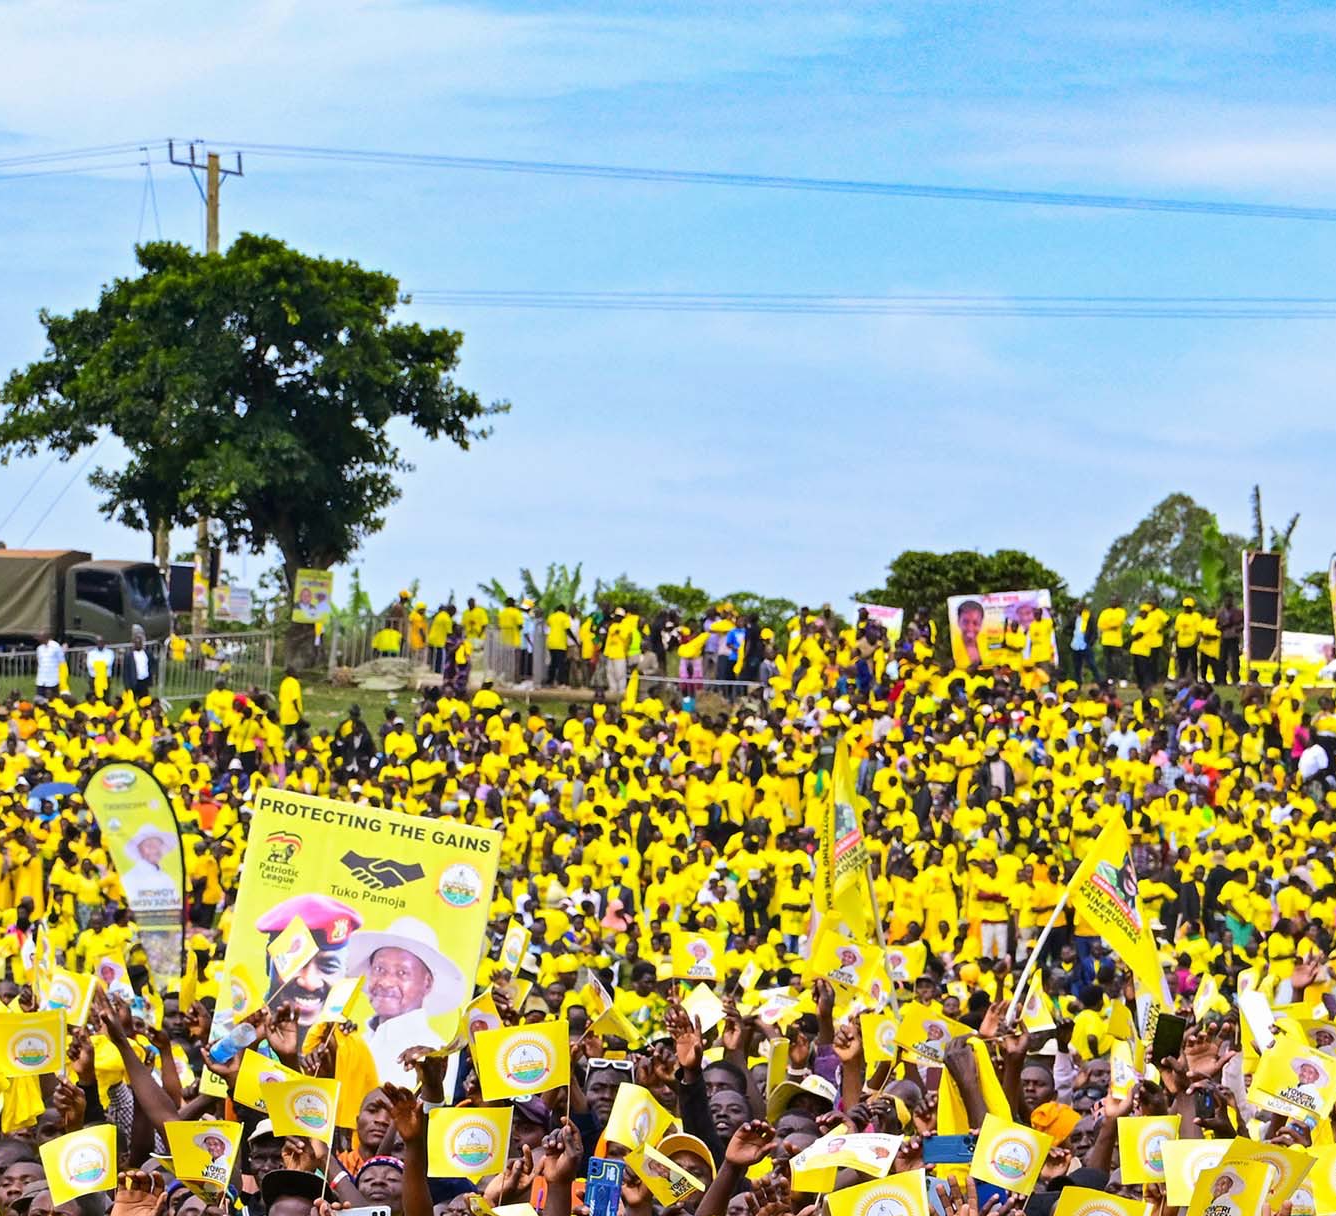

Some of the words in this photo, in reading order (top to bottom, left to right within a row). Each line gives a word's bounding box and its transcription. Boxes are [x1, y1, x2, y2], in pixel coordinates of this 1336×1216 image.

[260, 797, 382, 833] PROTECTING
[388, 821, 425, 841] THE
[431, 831, 491, 853] GAINS
[258, 862, 299, 878] Patriotic
[261, 873, 295, 885] League
[330, 884, 359, 901] Tuko
[362, 889, 406, 909] Pamoja
